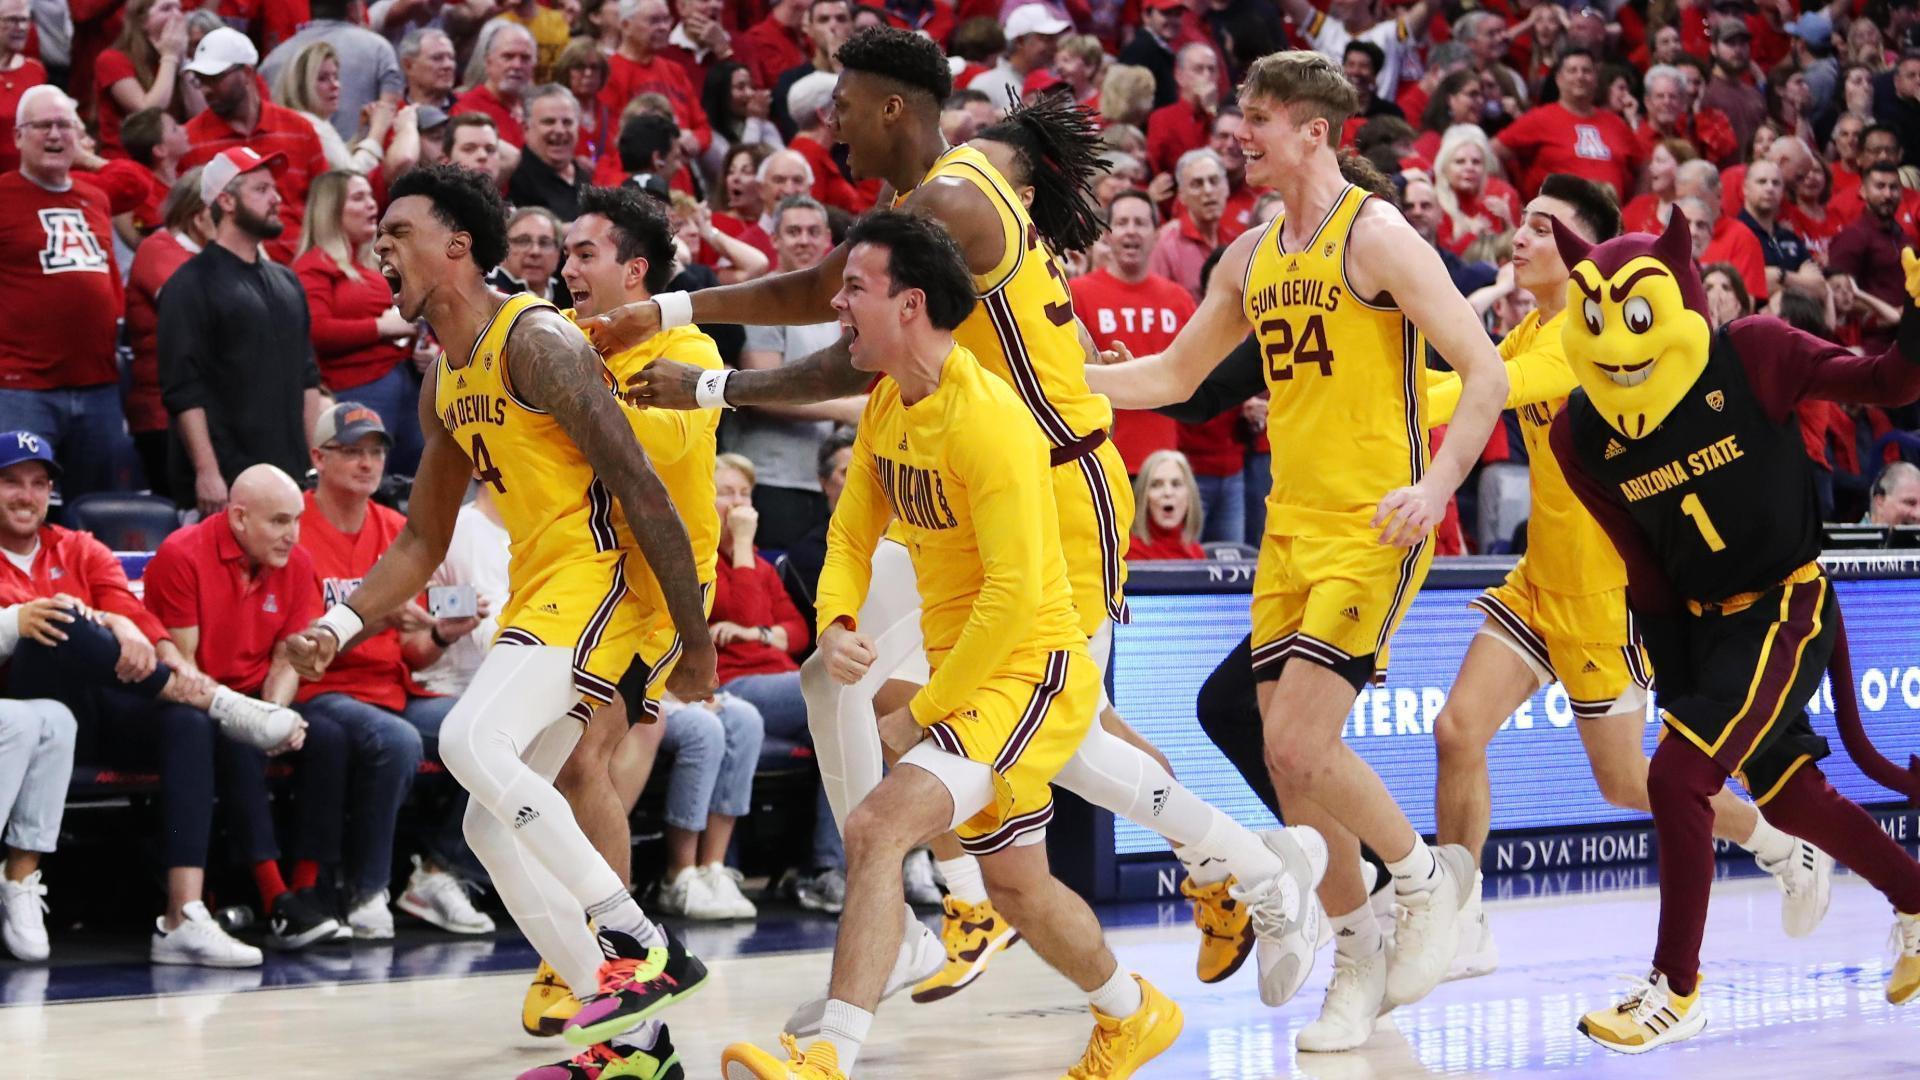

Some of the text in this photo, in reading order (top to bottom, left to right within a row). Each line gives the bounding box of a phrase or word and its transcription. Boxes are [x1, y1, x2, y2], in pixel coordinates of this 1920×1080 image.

[1574, 124, 1611, 161] A
[38, 207, 109, 275] A
[1251, 279, 1342, 321] SUN DEVILS
[1097, 307, 1177, 334] BTFD
[1260, 314, 1335, 381] 24
[443, 395, 507, 435] UN DEVILS
[16, 432, 40, 454] KC
[471, 433, 508, 494] 4
[1619, 434, 1745, 503] ARIZONA STATE
[1680, 492, 1727, 553] 1
[1153, 785, 1173, 817] adidas
[1581, 832, 1648, 864] HOME
[1880, 815, 1907, 841] ME
